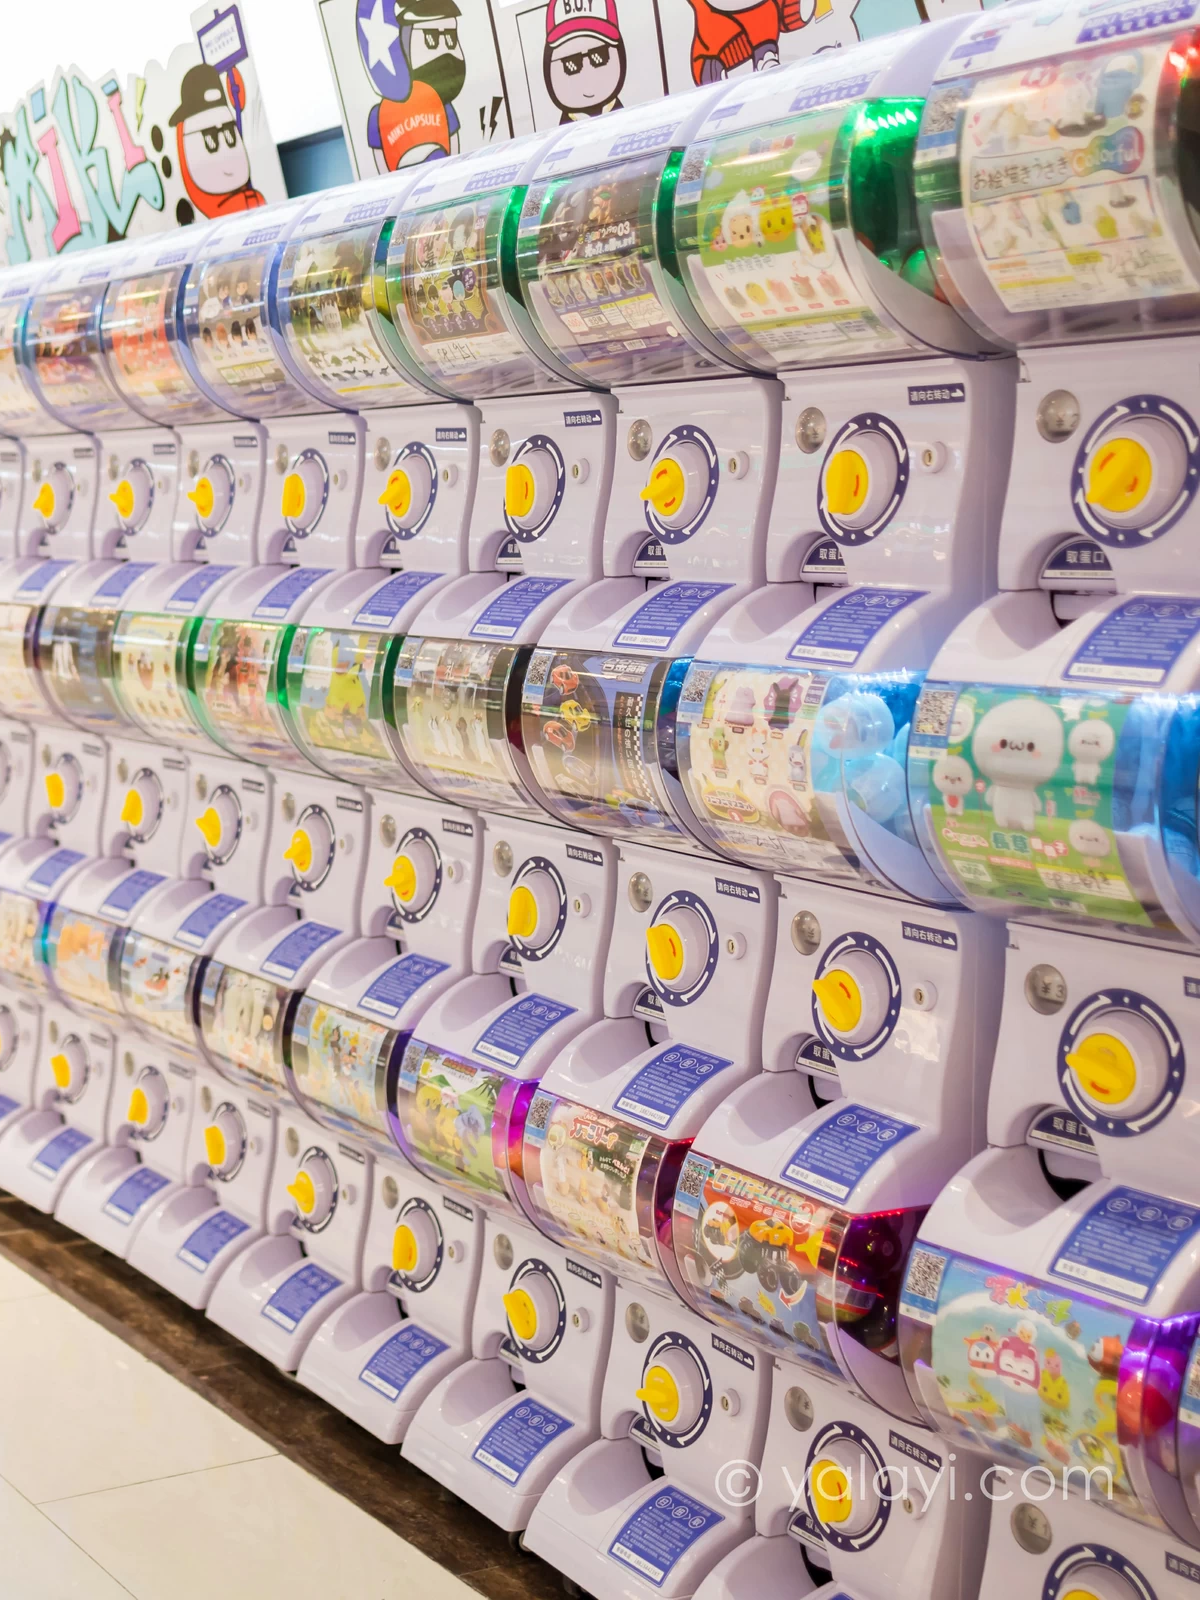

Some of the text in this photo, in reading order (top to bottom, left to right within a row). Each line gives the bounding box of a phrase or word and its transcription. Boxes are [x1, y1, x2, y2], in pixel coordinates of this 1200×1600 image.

[387, 113, 441, 145] MIKI CAPSULE
[910, 389, 950, 401] 请向右转动
[565, 414, 592, 425] 请向右转动
[648, 545, 665, 556] 取蛋
[1066, 550, 1104, 564] 取蛋口
[717, 882, 748, 898] 请向右转动
[904, 927, 942, 944] 请向右转动
[813, 1044, 831, 1060] 取蛋
[1052, 1116, 1089, 1137] 取蛋口
[713, 1336, 744, 1361] 请向右转动
[890, 1435, 928, 1462] 请向右转动
